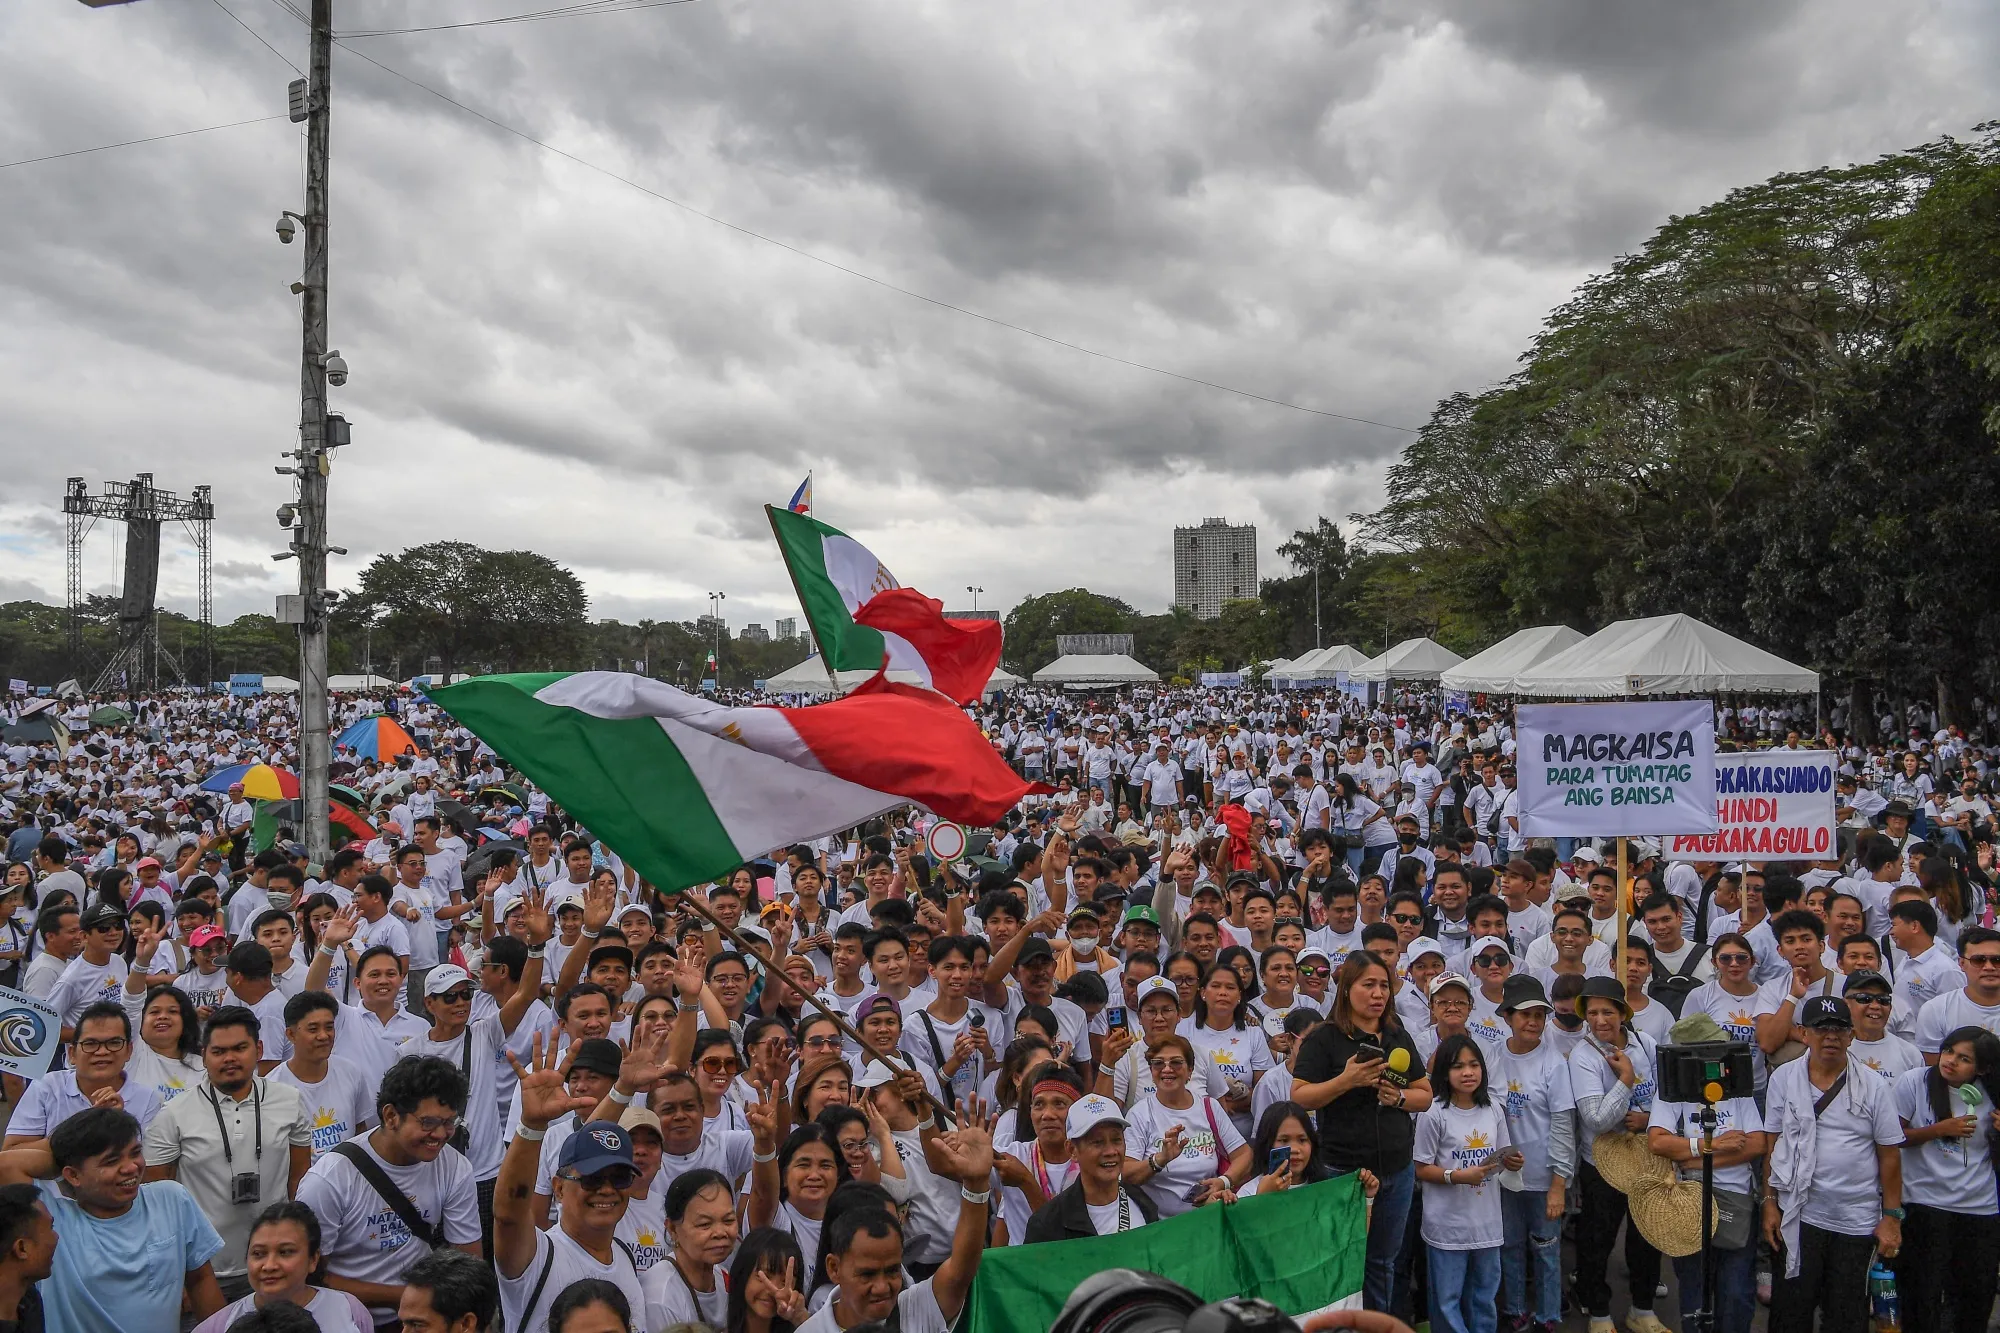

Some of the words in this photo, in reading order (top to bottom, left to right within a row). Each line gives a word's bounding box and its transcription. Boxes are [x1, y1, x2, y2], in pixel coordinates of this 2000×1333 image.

[1543, 731, 1695, 763] MAGKAISA
[1547, 768, 1594, 785] PARA
[1602, 764, 1691, 784] TUMATAG
[1564, 788, 1604, 807] ANG
[1610, 786, 1675, 806] BANSA
[1672, 826, 1829, 854] PAGKAKAGULO
[1821, 999, 1837, 1013] NY
[1469, 1022, 1506, 1037] NATIONAL
[1474, 1030, 1499, 1040] RALLY
[1717, 1023, 1757, 1037] ATION
[1219, 1063, 1247, 1074] ONAL
[1382, 1069, 1408, 1086] NET25
[1636, 1081, 1654, 1092] ONAL
[1507, 1091, 1531, 1101] TIONAL
[1507, 1097, 1523, 1106] ALLY
[311, 1121, 348, 1139] ATIONAL
[1452, 1147, 1496, 1161] NATIONA
[1463, 1159, 1481, 1168] RAL
[380, 1221, 404, 1235] RAL
[627, 1243, 667, 1258] NAONAL
